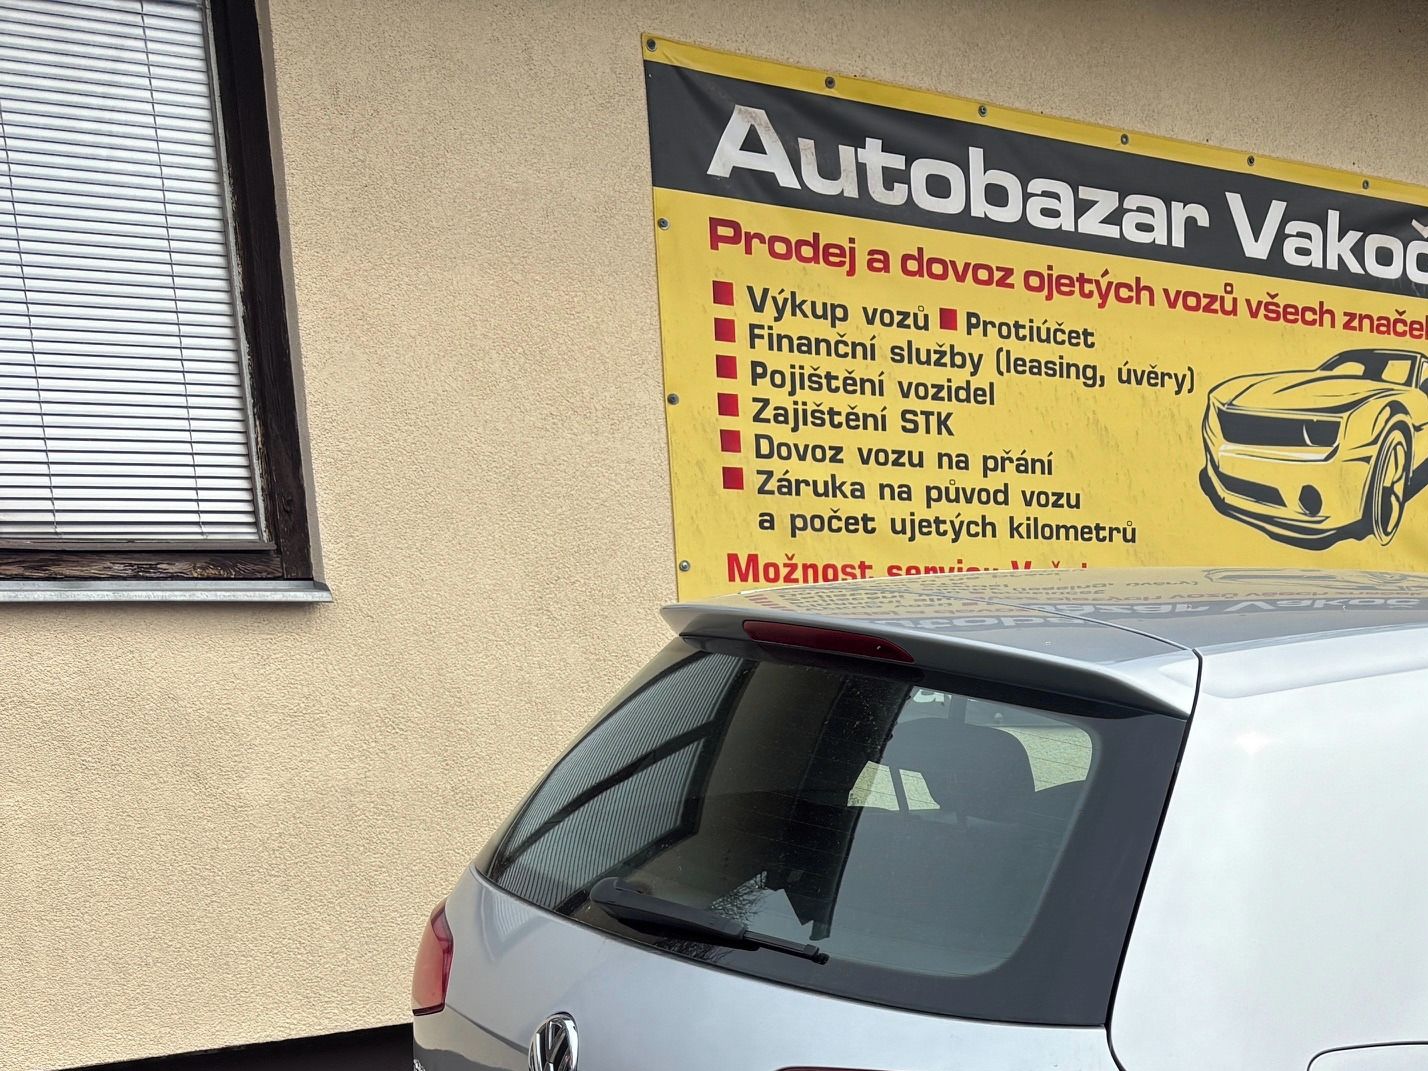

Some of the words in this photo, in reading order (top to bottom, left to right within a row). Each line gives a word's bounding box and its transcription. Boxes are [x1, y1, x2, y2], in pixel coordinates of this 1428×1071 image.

[706, 104, 1210, 249] Autobazar
[708, 217, 856, 277] Prodej
[866, 249, 891, 275] a
[900, 246, 1015, 290] dovoz
[1023, 265, 1155, 309] ojetých
[1163, 282, 1238, 317] vozů
[1245, 292, 1335, 329] všech
[746, 285, 849, 328] Výkup
[862, 305, 930, 332] vozů
[965, 311, 1096, 349] Protiúčet
[748, 323, 876, 361] Finanční
[890, 340, 983, 377] služby
[995, 346, 1106, 388] (leasing,
[1117, 360, 1195, 395] úvěry)
[750, 360, 884, 397] Pojištění
[897, 378, 995, 405] vozidel
[751, 397, 887, 433] Zajištění
[900, 408, 955, 436] STK
[754, 433, 844, 464] Dovoz
[857, 446, 924, 468] vozu
[937, 451, 970, 471] na
[982, 449, 1053, 478] přání
[756, 469, 866, 499] Záruka
[879, 482, 912, 502] na
[925, 479, 1009, 509] původ
[1021, 489, 1081, 510] vozu
[758, 511, 775, 531] a
[790, 507, 876, 538] počet
[890, 512, 997, 543] ujetých
[1009, 516, 1136, 544] kilometrů
[727, 553, 873, 585] Možnost
